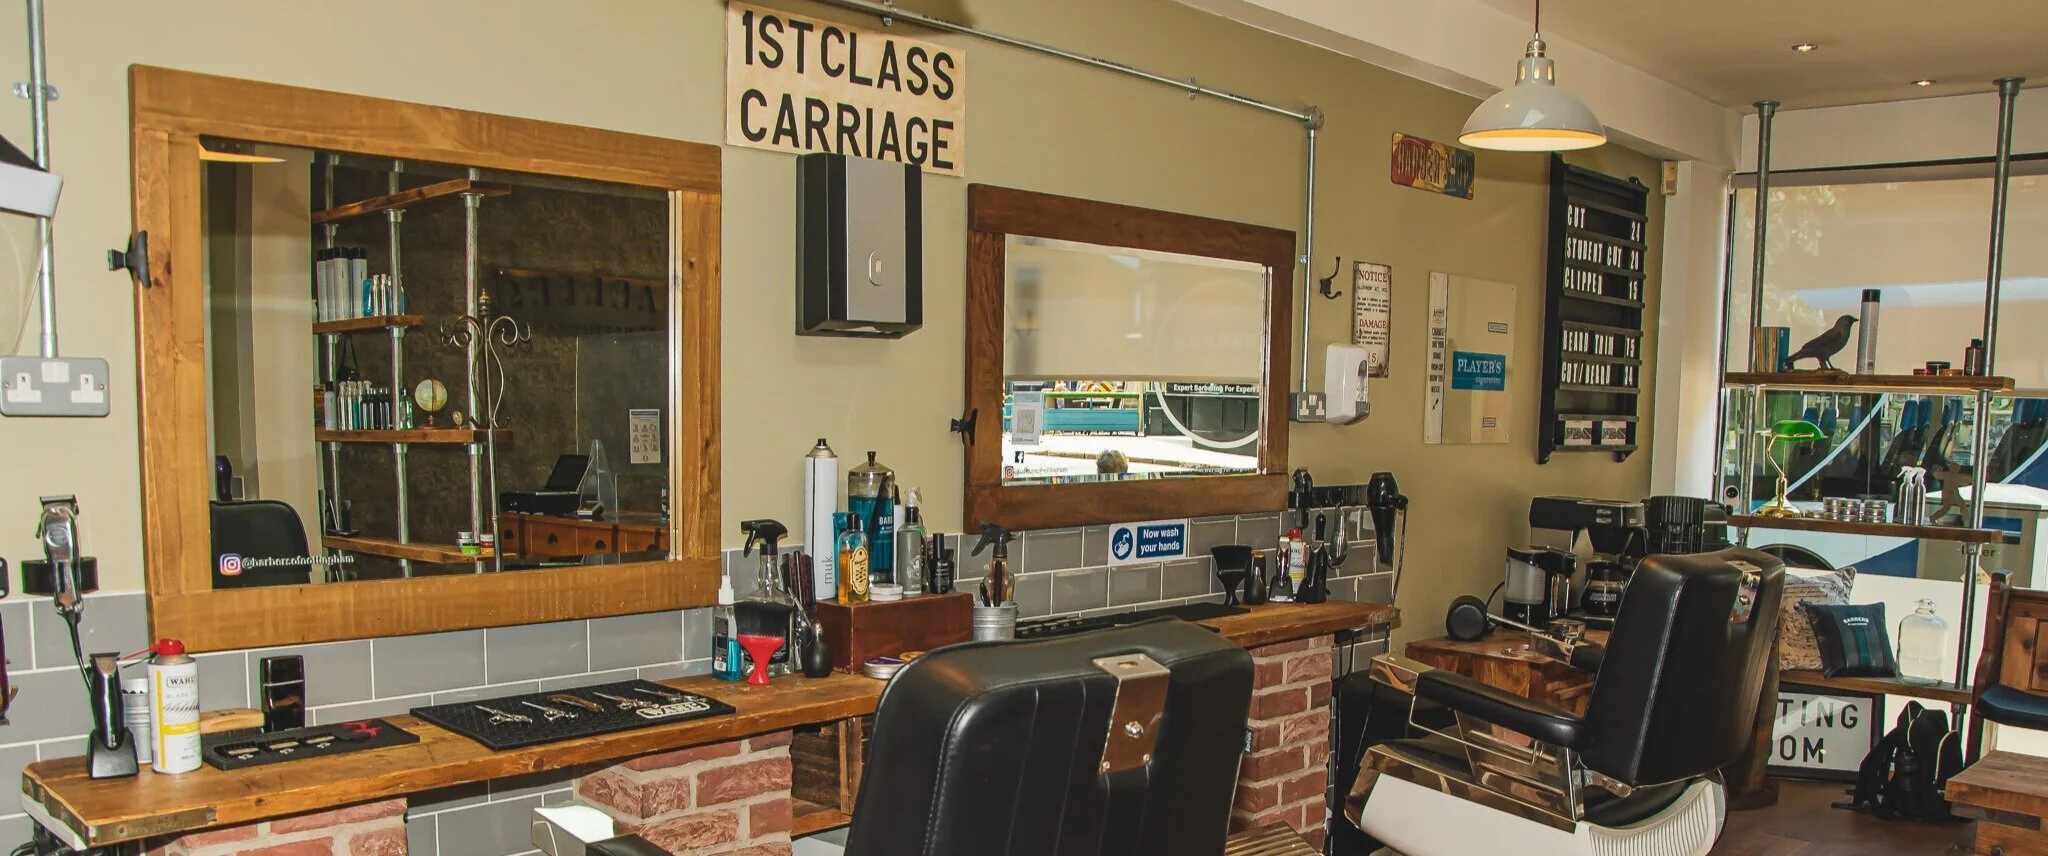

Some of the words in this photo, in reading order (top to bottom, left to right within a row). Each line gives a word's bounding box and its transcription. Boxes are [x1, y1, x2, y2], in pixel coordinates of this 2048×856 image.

[740, 88, 954, 170] CARRIAGE
[1567, 204, 1585, 229] CUT
[1631, 221, 1641, 242] 24
[1566, 237, 1603, 264] STUDENT
[1606, 245, 1622, 269] CUT
[1630, 250, 1639, 271] 20
[1358, 270, 1388, 283] NOTICE
[1564, 266, 1603, 295] CLIPPER
[1629, 280, 1638, 301] 15
[1359, 318, 1387, 329] DAMAGE
[1562, 330, 1589, 352] BEARD
[1594, 333, 1614, 356] TRIM
[1457, 359, 1502, 374] PLAYER'S
[1173, 383, 1193, 393] Expert
[1194, 383, 1224, 393] Barbering
[1224, 384, 1235, 393] For
[1143, 528, 1160, 540] Now
[1161, 527, 1179, 537] wash
[1141, 543, 1158, 555] your
[1158, 540, 1180, 552] hands
[1777, 698, 1859, 730] TING
[1779, 734, 1825, 764] OM
